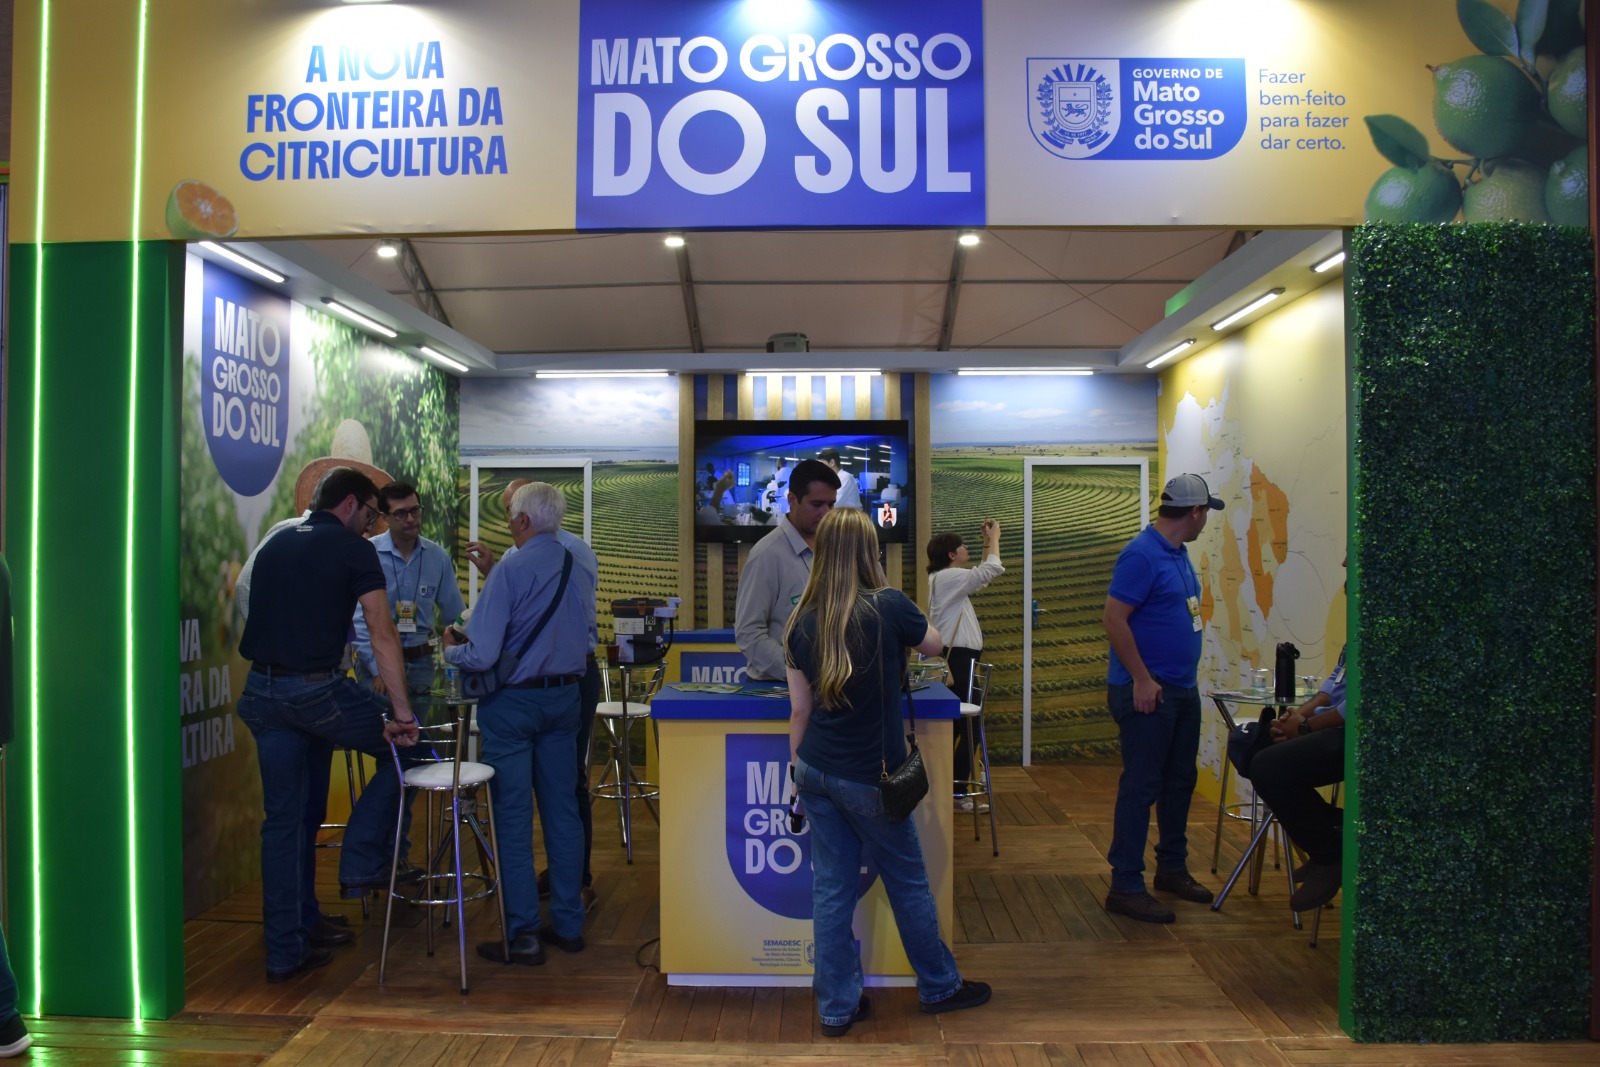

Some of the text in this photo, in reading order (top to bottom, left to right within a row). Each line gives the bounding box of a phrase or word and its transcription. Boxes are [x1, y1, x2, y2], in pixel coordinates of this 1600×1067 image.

[306, 41, 444, 83] A NOVA
[591, 32, 972, 85] MATO GROSSO
[1132, 68, 1223, 79] GOVERNO DE
[1259, 69, 1306, 84] Fazer
[247, 87, 504, 133] FRONTEIRA DA
[1133, 81, 1200, 102] Mato
[1259, 90, 1346, 106] bem-feito
[1133, 104, 1225, 126] Grosso
[1260, 113, 1349, 132] para fazer
[239, 135, 508, 181] CITRICULTURA
[592, 87, 972, 197] DO SUL
[1134, 127, 1213, 150] do Sul
[1260, 135, 1346, 150] dar certo.
[215, 297, 281, 367] MATO
[212, 355, 281, 404] GROSSO
[212, 392, 280, 447] DO SUL
[209, 664, 232, 710] DA
[745, 838, 802, 875] DO
